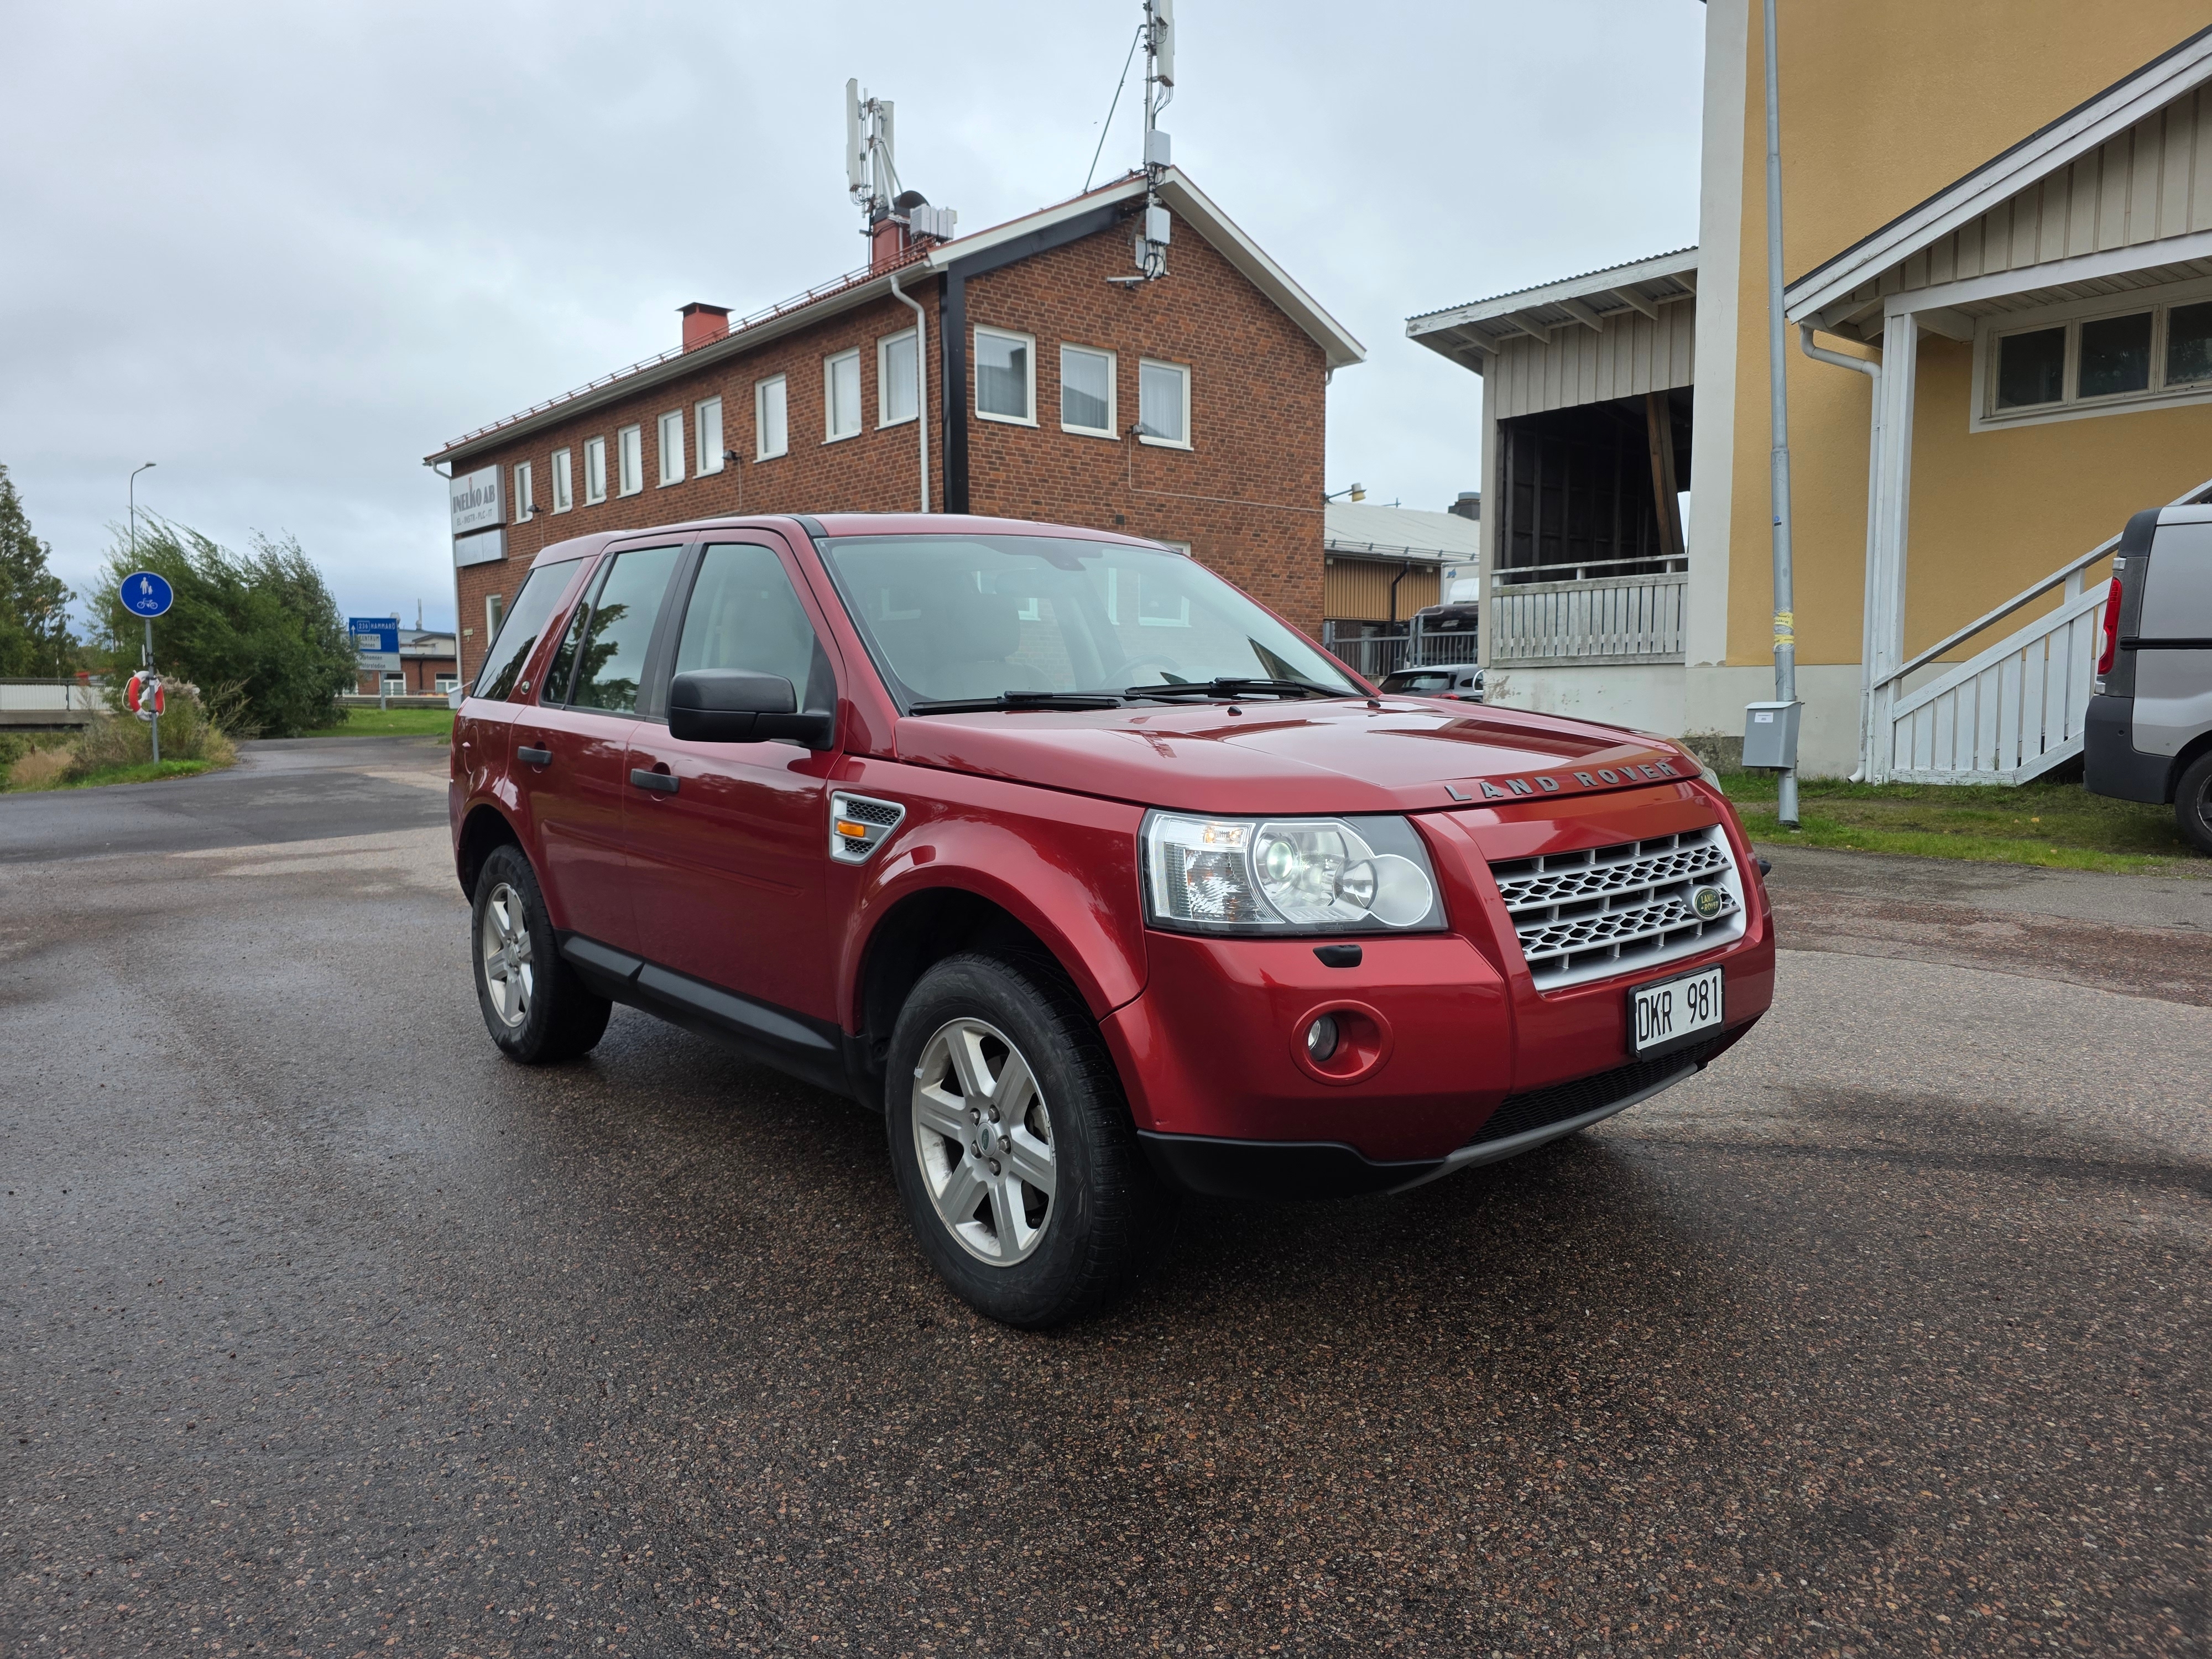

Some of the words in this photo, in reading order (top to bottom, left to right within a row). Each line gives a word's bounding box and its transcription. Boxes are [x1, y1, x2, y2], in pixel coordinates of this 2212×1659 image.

[453, 478, 482, 514] INELKO
[483, 484, 495, 505] AB
[488, 509, 493, 517] IT
[1444, 776, 1559, 801] LAND
[1573, 762, 1677, 787] ROVER
[1701, 894, 1714, 904] LAND
[1704, 901, 1719, 912] ROVER
[1638, 990, 1672, 1042] DKR
[1687, 975, 1718, 1024] 981
